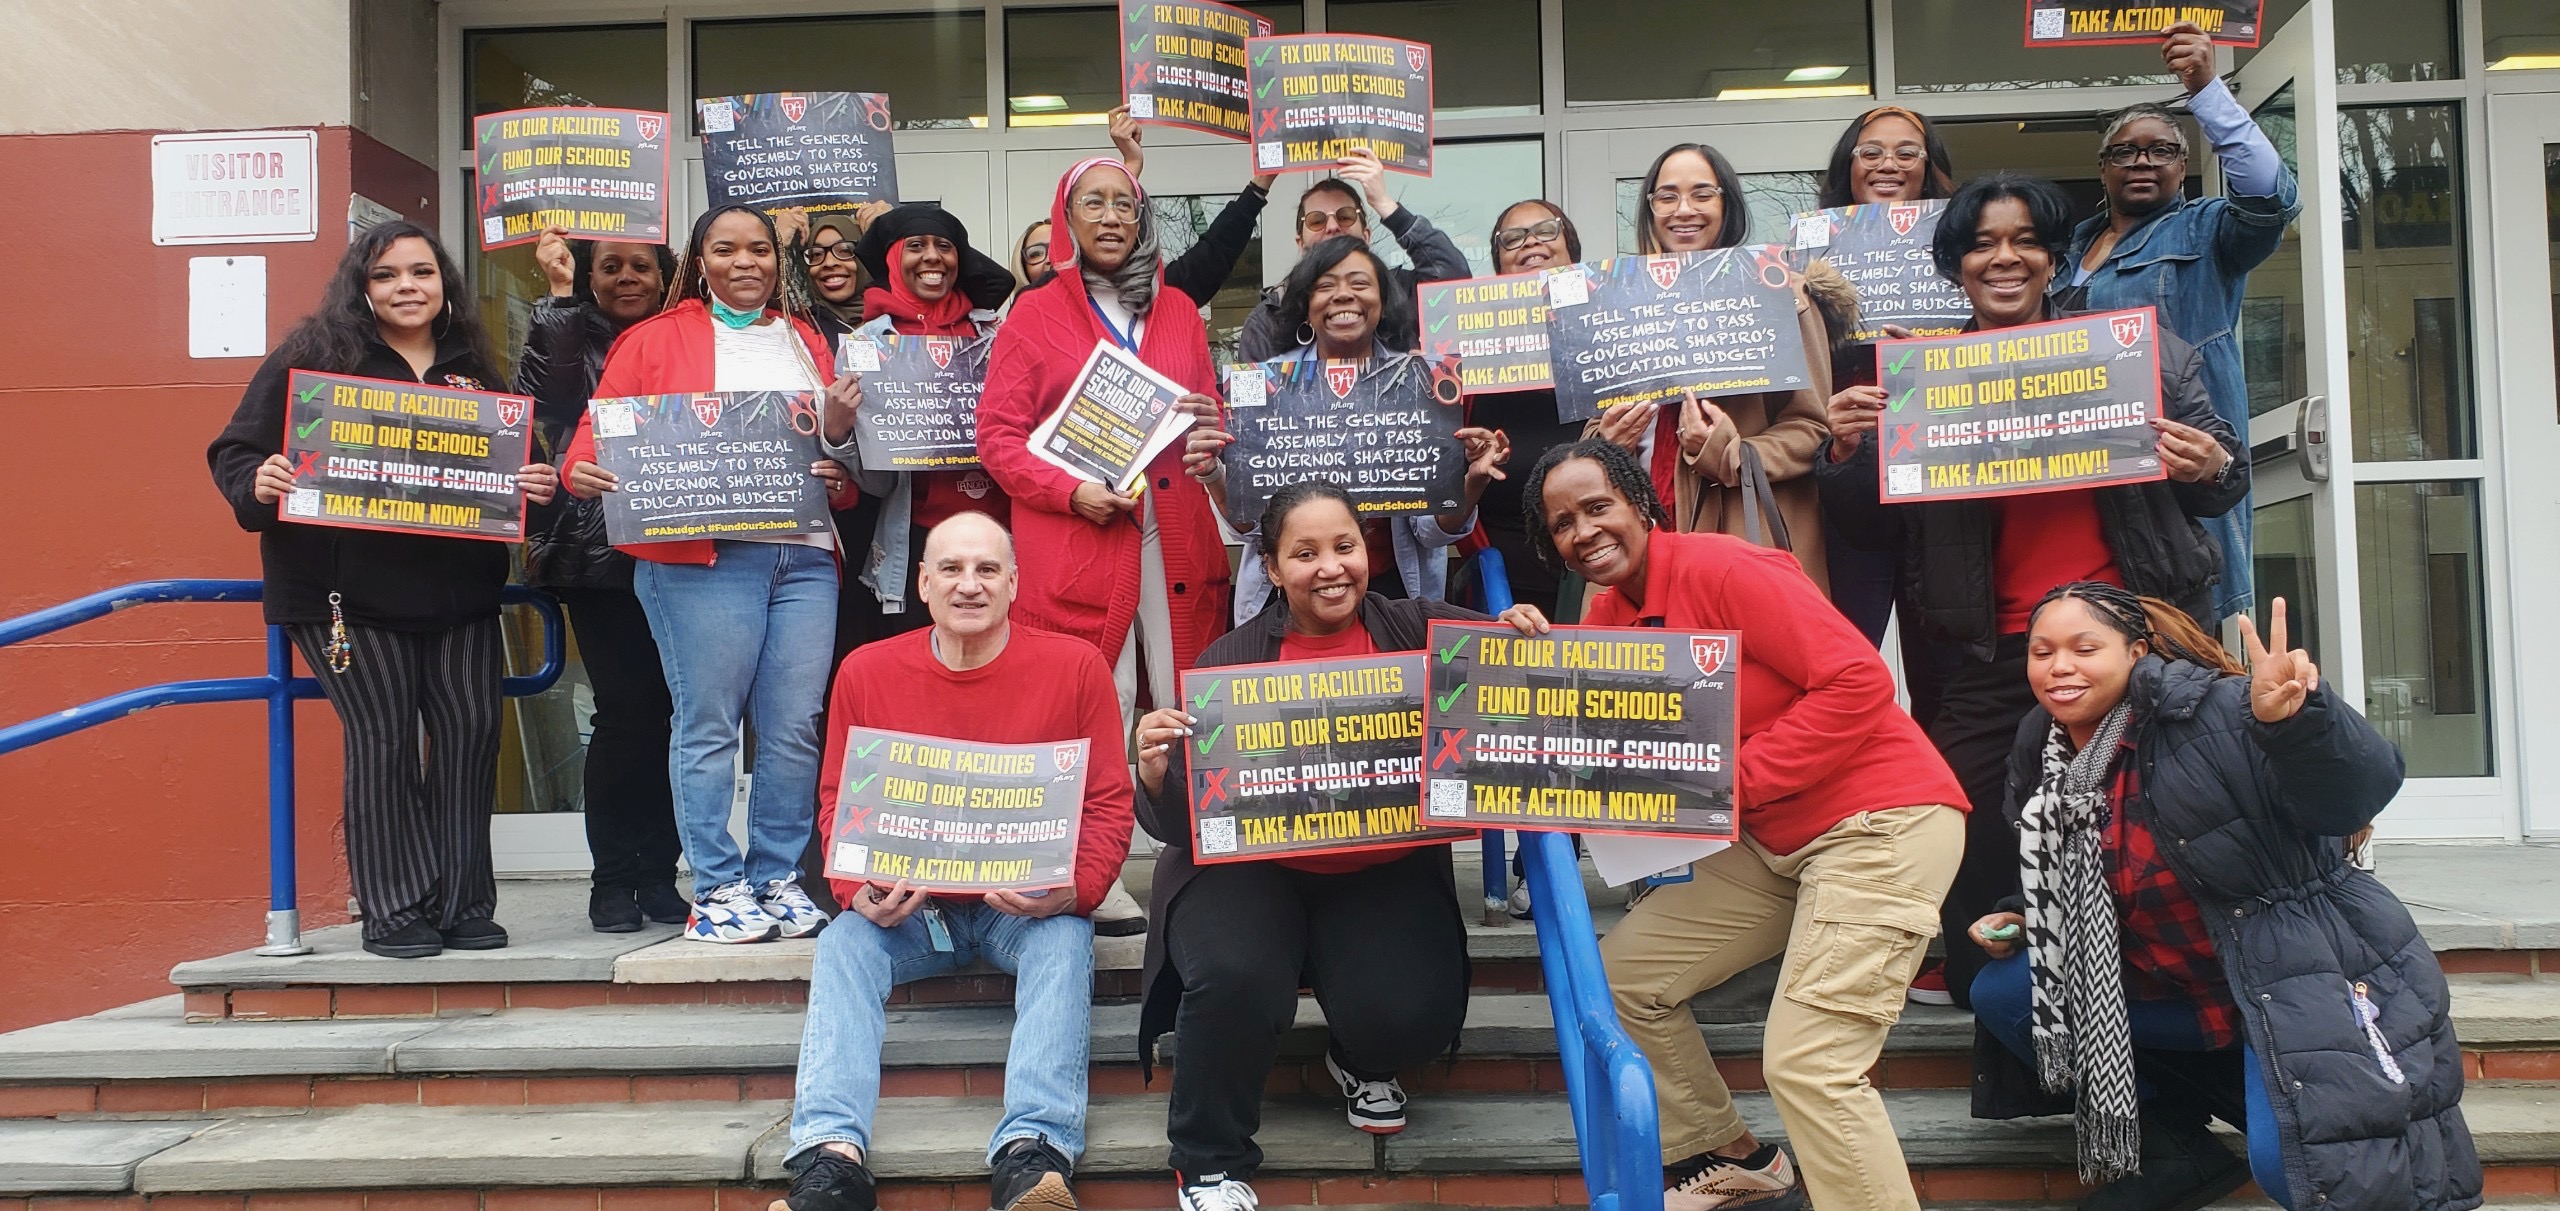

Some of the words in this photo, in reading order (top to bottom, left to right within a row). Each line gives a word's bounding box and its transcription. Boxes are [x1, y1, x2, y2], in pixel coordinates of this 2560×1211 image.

[1154, 5, 1172, 23] FIX
[1176, 9, 1201, 26] OUR
[1204, 12, 1249, 37] FACILITIES
[2070, 10, 2109, 33] TAKE
[2113, 8, 2176, 31] ACTION
[1156, 36, 1187, 55] FUND
[1191, 39, 1212, 59] OUR
[1281, 45, 1298, 65] FIX
[1303, 44, 1330, 63] OUR
[1335, 43, 1394, 65] FACILITIES
[1156, 65, 1192, 86] CLOSE
[1195, 70, 1229, 94] PUBLIC
[1283, 77, 1318, 96] FUND
[1322, 75, 1348, 94] OUR
[1352, 75, 1405, 98] SCHOOLS
[1157, 97, 1184, 117] TAKE
[1187, 102, 1222, 123] ACTION
[1285, 107, 1325, 129] CLOSE
[1329, 105, 1374, 124] PUBLIC
[1377, 108, 1424, 133] SCHOOLS
[503, 119, 519, 139] FIX
[522, 118, 547, 136] OUR
[552, 117, 620, 136] FACILITIES
[727, 139, 762, 151] TELL
[767, 137, 794, 147] THE
[800, 135, 868, 145] GENERAL
[736, 151, 802, 166] ASSEMBLY
[808, 149, 827, 159] TO
[833, 148, 862, 159] PASS
[1287, 142, 1318, 163] TAKE
[1371, 139, 1404, 163] NOW!!
[186, 152, 284, 180] VISITOR
[503, 149, 531, 170] FUND
[535, 147, 562, 165] OUR
[566, 147, 630, 168] SCHOOLS
[724, 165, 803, 181] GOVERNOR
[809, 161, 878, 174] SHAPIRO'S
[504, 181, 536, 202] CLOSE
[539, 177, 587, 196] PUBLIC
[590, 179, 655, 201] SCHOOLS
[728, 180, 808, 197] EDUCATION
[813, 176, 877, 189] BUDGET!
[170, 189, 300, 218] ENTRANCE
[505, 213, 530, 236] TAKE
[532, 210, 575, 231] ACTION
[580, 211, 625, 232] NOW!!
[1579, 311, 1625, 328] TELL
[1631, 304, 1665, 320] THE
[1673, 297, 1761, 314] GENERAL
[1592, 320, 1677, 344] ASSEMBLY
[1684, 316, 1708, 331] TO
[1715, 313, 1754, 329] PASS
[1575, 338, 1678, 364] GOVERNOR
[1685, 329, 1776, 348] SHAPIRO'S
[1924, 345, 1950, 372] FIX
[1955, 343, 1991, 369] OUR
[1998, 329, 2089, 362] FACILITIES
[1581, 354, 1686, 383] EDUCATION
[1692, 345, 1775, 364] BUDGET!
[1097, 357, 1131, 385] SAVE
[1127, 376, 1156, 402] OUR
[1330, 372, 1353, 390] pft
[1926, 384, 1973, 410] FUND
[1979, 379, 2017, 405] OUR
[2022, 367, 2107, 399] SCHOOLS
[333, 385, 359, 407] FIX
[361, 389, 395, 412] OUR
[400, 393, 478, 421] FACILITIES
[1086, 373, 1146, 420] SCHOOLS
[697, 402, 720, 422] pft
[1256, 417, 1298, 432] TELL
[1305, 415, 1339, 429] THE
[1345, 411, 1431, 428] GENERAL
[1928, 421, 1981, 448] CLOSE
[1987, 413, 2052, 442] PUBLIC
[2058, 402, 2145, 435] SCHOOLS
[330, 421, 373, 445] FUND
[378, 426, 412, 449] OUR
[416, 431, 489, 458] SCHOOLS
[628, 445, 671, 458] TELL
[676, 443, 709, 456] THE
[716, 440, 793, 454] GENERAL
[1265, 433, 1347, 450] ASSEMBLY
[1354, 432, 1377, 445] TO
[1385, 430, 1422, 445] PASS
[640, 459, 719, 475] ASSEMBLY
[725, 459, 747, 471] TO
[754, 457, 787, 470] PASS
[1249, 451, 1346, 468] GOVERNOR
[1354, 446, 1440, 465] SHAPIRO'S
[1928, 464, 1970, 488] TAKE
[1976, 458, 2042, 485] ACTION
[2048, 449, 2109, 478] NOW!!
[328, 456, 379, 481] CLOSE
[381, 461, 440, 487] PUBLIC
[443, 468, 515, 495] SCHOOLS
[625, 475, 720, 493] GOVERNOR
[726, 472, 804, 488] SHAPIRO'S
[1253, 470, 1351, 487] EDUCATION
[1358, 465, 1436, 483] BUDGET!
[325, 494, 363, 518] TAKE
[367, 498, 424, 522] ACTION
[430, 504, 480, 528] NOW!!
[630, 493, 727, 510] EDUCATION
[732, 490, 803, 506] BUDGET!
[645, 524, 706, 536] #PAbudget
[708, 521, 797, 533] #FundOurSchools
[1480, 637, 1507, 666] FIX
[1513, 639, 1555, 667] OUR
[1562, 641, 1664, 671] FACILITIES
[1694, 643, 1723, 667] pft
[1232, 678, 1259, 705] FIX
[1264, 675, 1303, 703] OUR
[1309, 667, 1403, 699] FACILITIES
[1693, 680, 1725, 690] pft.org
[1477, 686, 1529, 715] FUND
[1537, 688, 1578, 716] OUR
[1585, 690, 1682, 721] SCHOOLS
[1235, 721, 1285, 751] FUND
[1291, 718, 1330, 747] OUR
[1335, 710, 1422, 743] SCHOOLS
[889, 741, 913, 764] FIX
[917, 746, 951, 769] OUR
[955, 751, 1035, 775] FACILITIES
[1476, 733, 1536, 764] CLOSE
[1543, 737, 1617, 768] PUBLIC
[1623, 740, 1721, 772] SCHOOLS
[884, 776, 927, 803] FUND
[932, 783, 966, 807] OUR
[970, 786, 1044, 809] SCHOOLS
[1238, 765, 1296, 797] CLOSE
[1302, 760, 1368, 791] PUBLIC
[1473, 785, 1521, 814] TAKE
[1526, 788, 1600, 818] ACTION
[1608, 791, 1676, 822] NOW!!
[878, 813, 929, 840] CLOSE
[932, 820, 992, 844] PUBLIC
[996, 818, 1067, 843] SCHOOLS
[1242, 816, 1287, 845] TAKE
[1293, 810, 1360, 841] ACTION
[873, 851, 911, 878] TAKE
[914, 857, 975, 881] ACTION
[980, 859, 1032, 883] NOW!!
